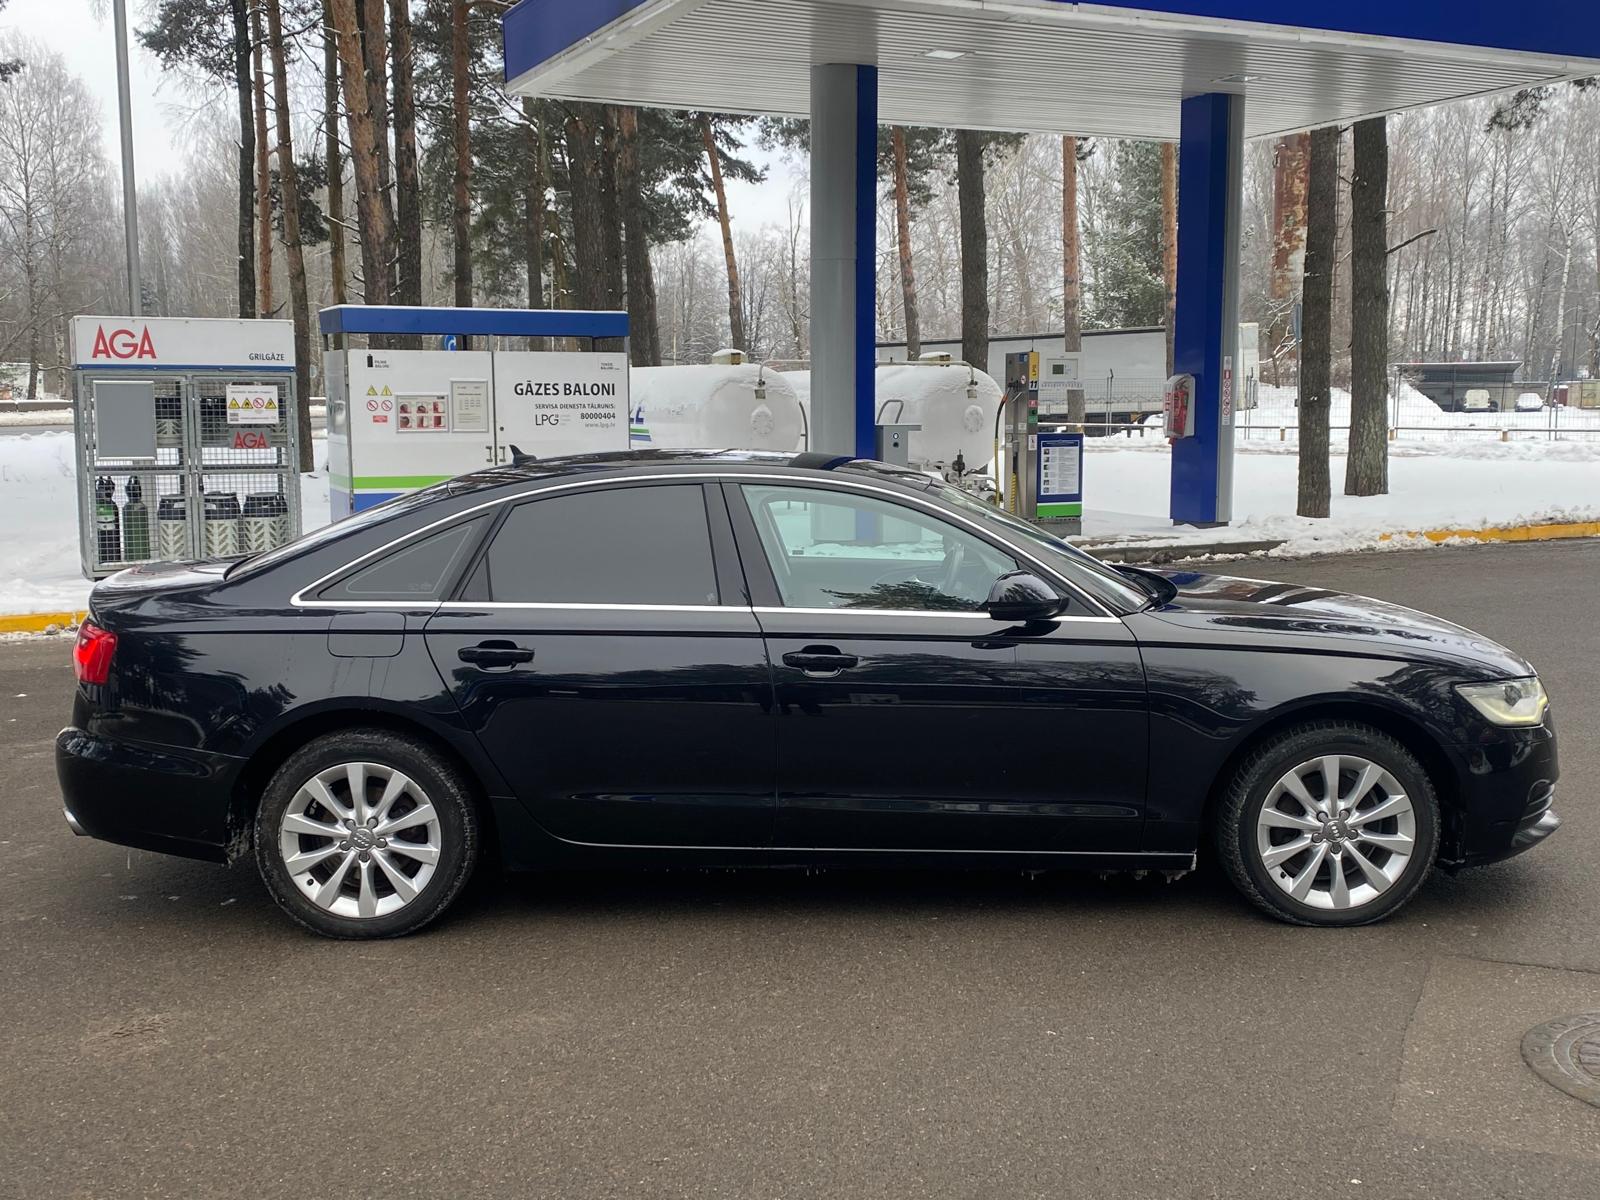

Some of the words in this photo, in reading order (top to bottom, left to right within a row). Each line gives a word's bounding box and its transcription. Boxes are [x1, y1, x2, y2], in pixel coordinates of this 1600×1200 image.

[92, 324, 157, 359] AGA
[514, 380, 560, 396] GĀZES
[563, 382, 615, 396] BALONI
[535, 414, 559, 426] LPG
[580, 412, 616, 420] 80000404
[234, 431, 267, 449] AGA
